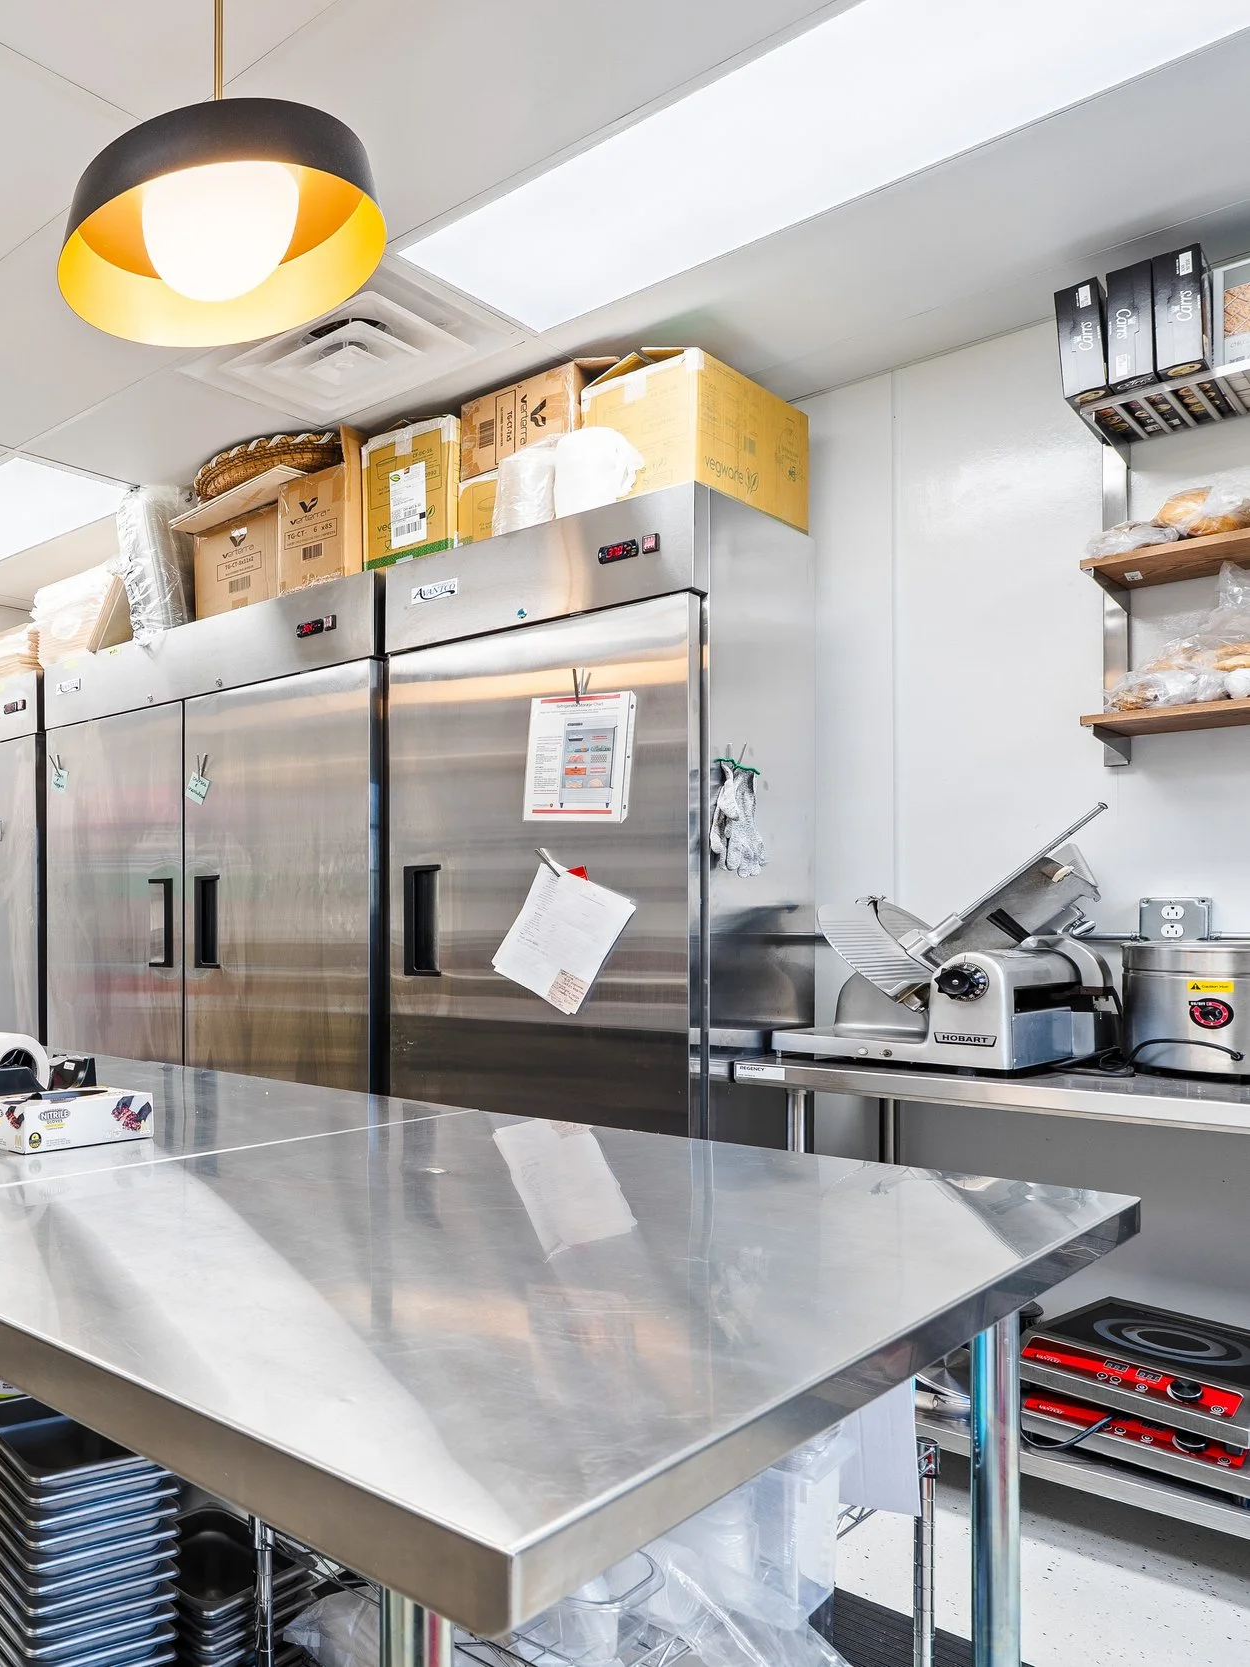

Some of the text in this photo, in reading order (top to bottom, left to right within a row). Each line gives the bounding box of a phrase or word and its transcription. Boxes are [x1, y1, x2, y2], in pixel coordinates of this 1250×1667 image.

[705, 454, 744, 485] vegware
[942, 1034, 989, 1044] HOBART
[40, 1110, 69, 1120] NITRILE
